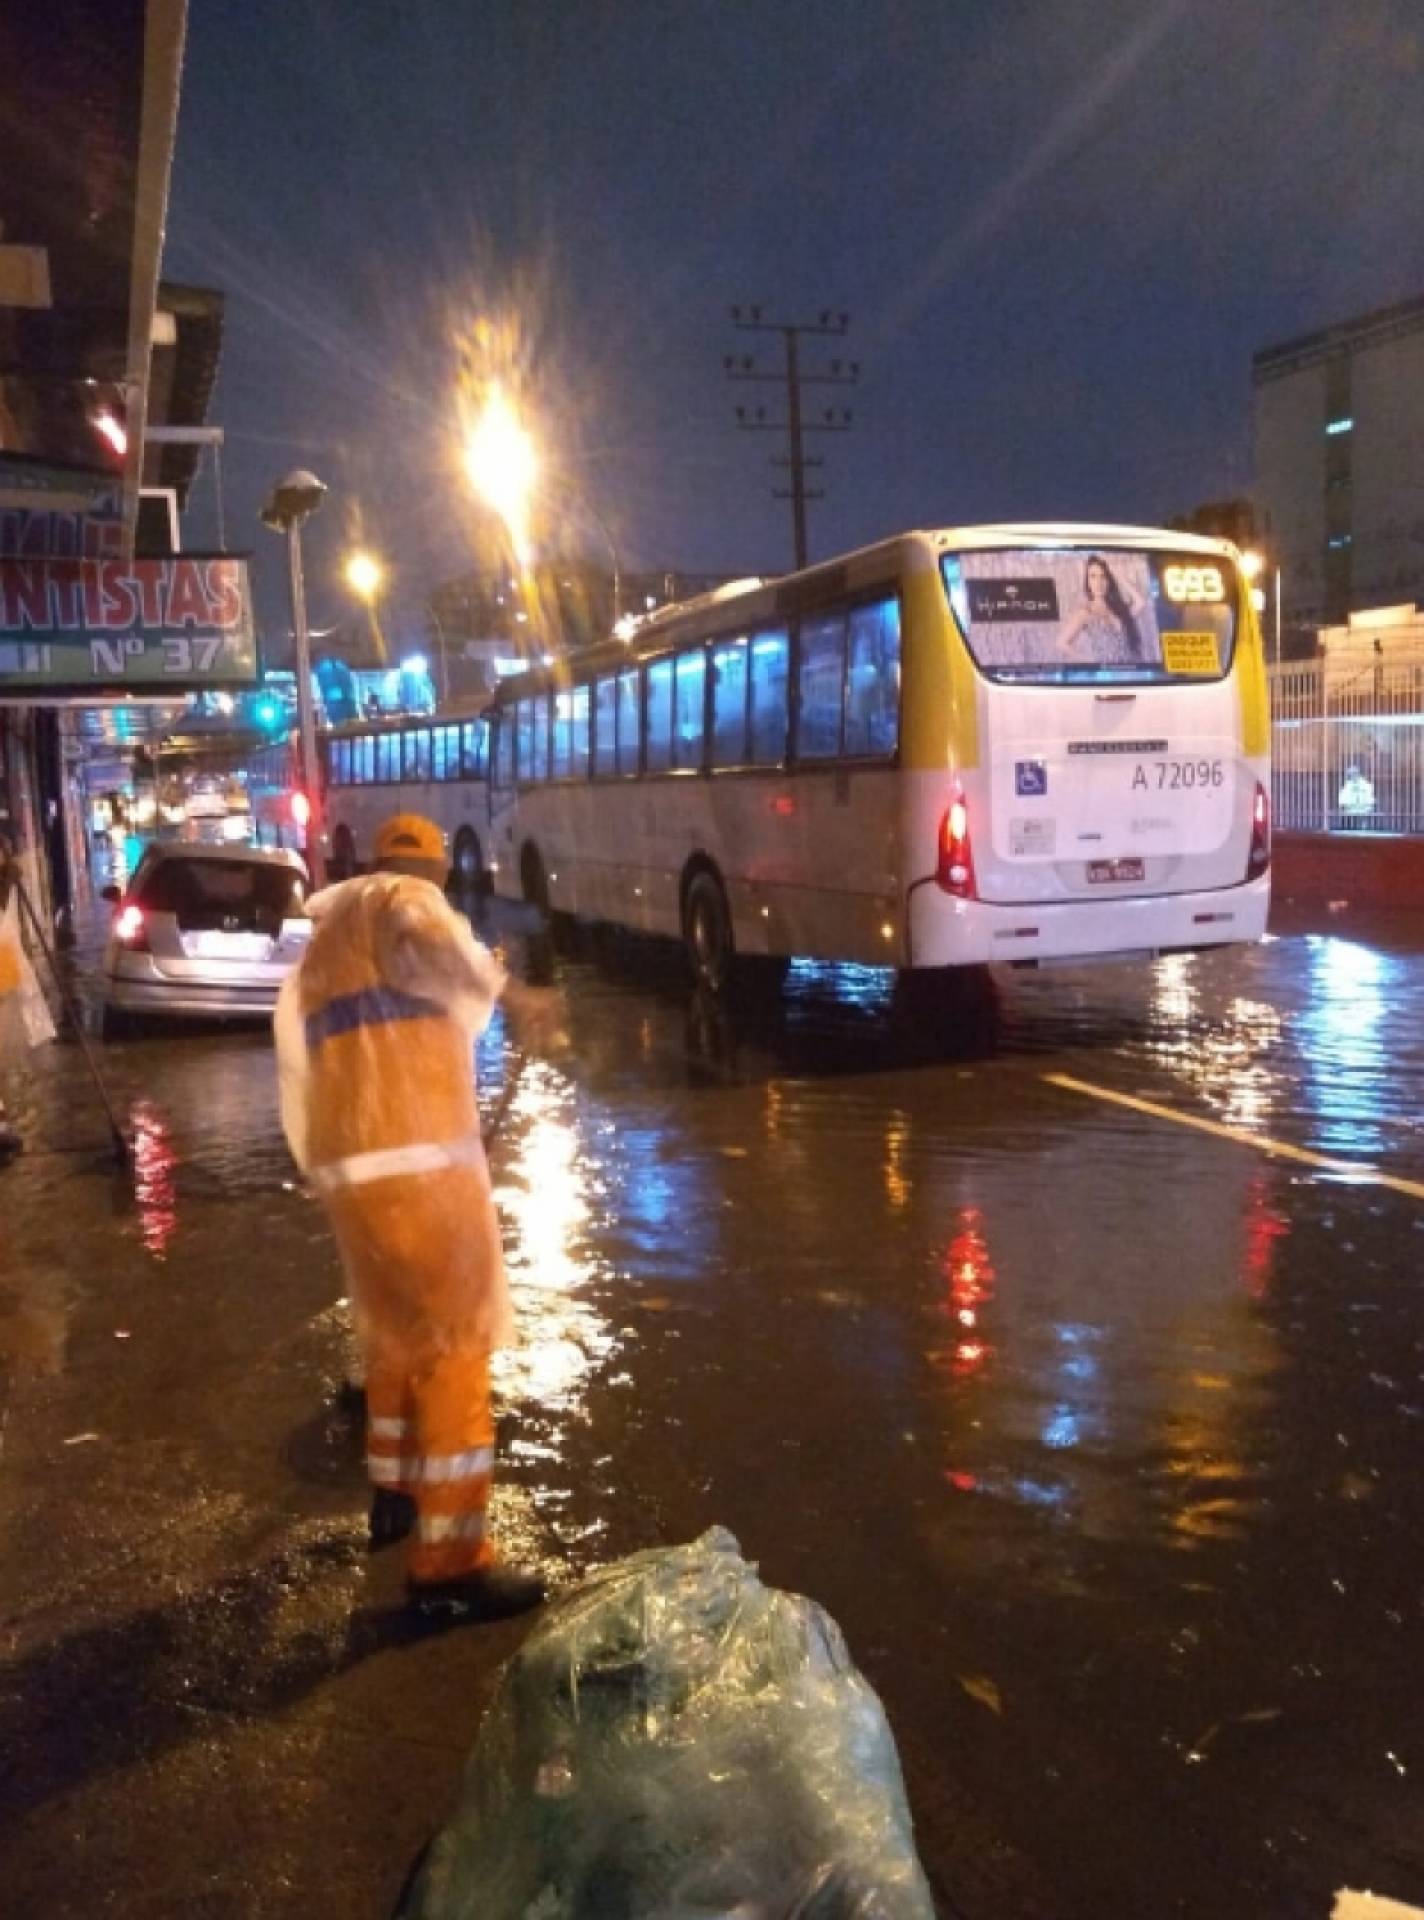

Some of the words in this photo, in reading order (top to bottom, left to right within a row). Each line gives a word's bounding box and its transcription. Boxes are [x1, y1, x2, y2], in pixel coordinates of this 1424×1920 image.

[1163, 566, 1224, 602] 693
[161, 636, 222, 673] 37
[1132, 763, 1148, 790] A
[1154, 759, 1224, 790] 72096
